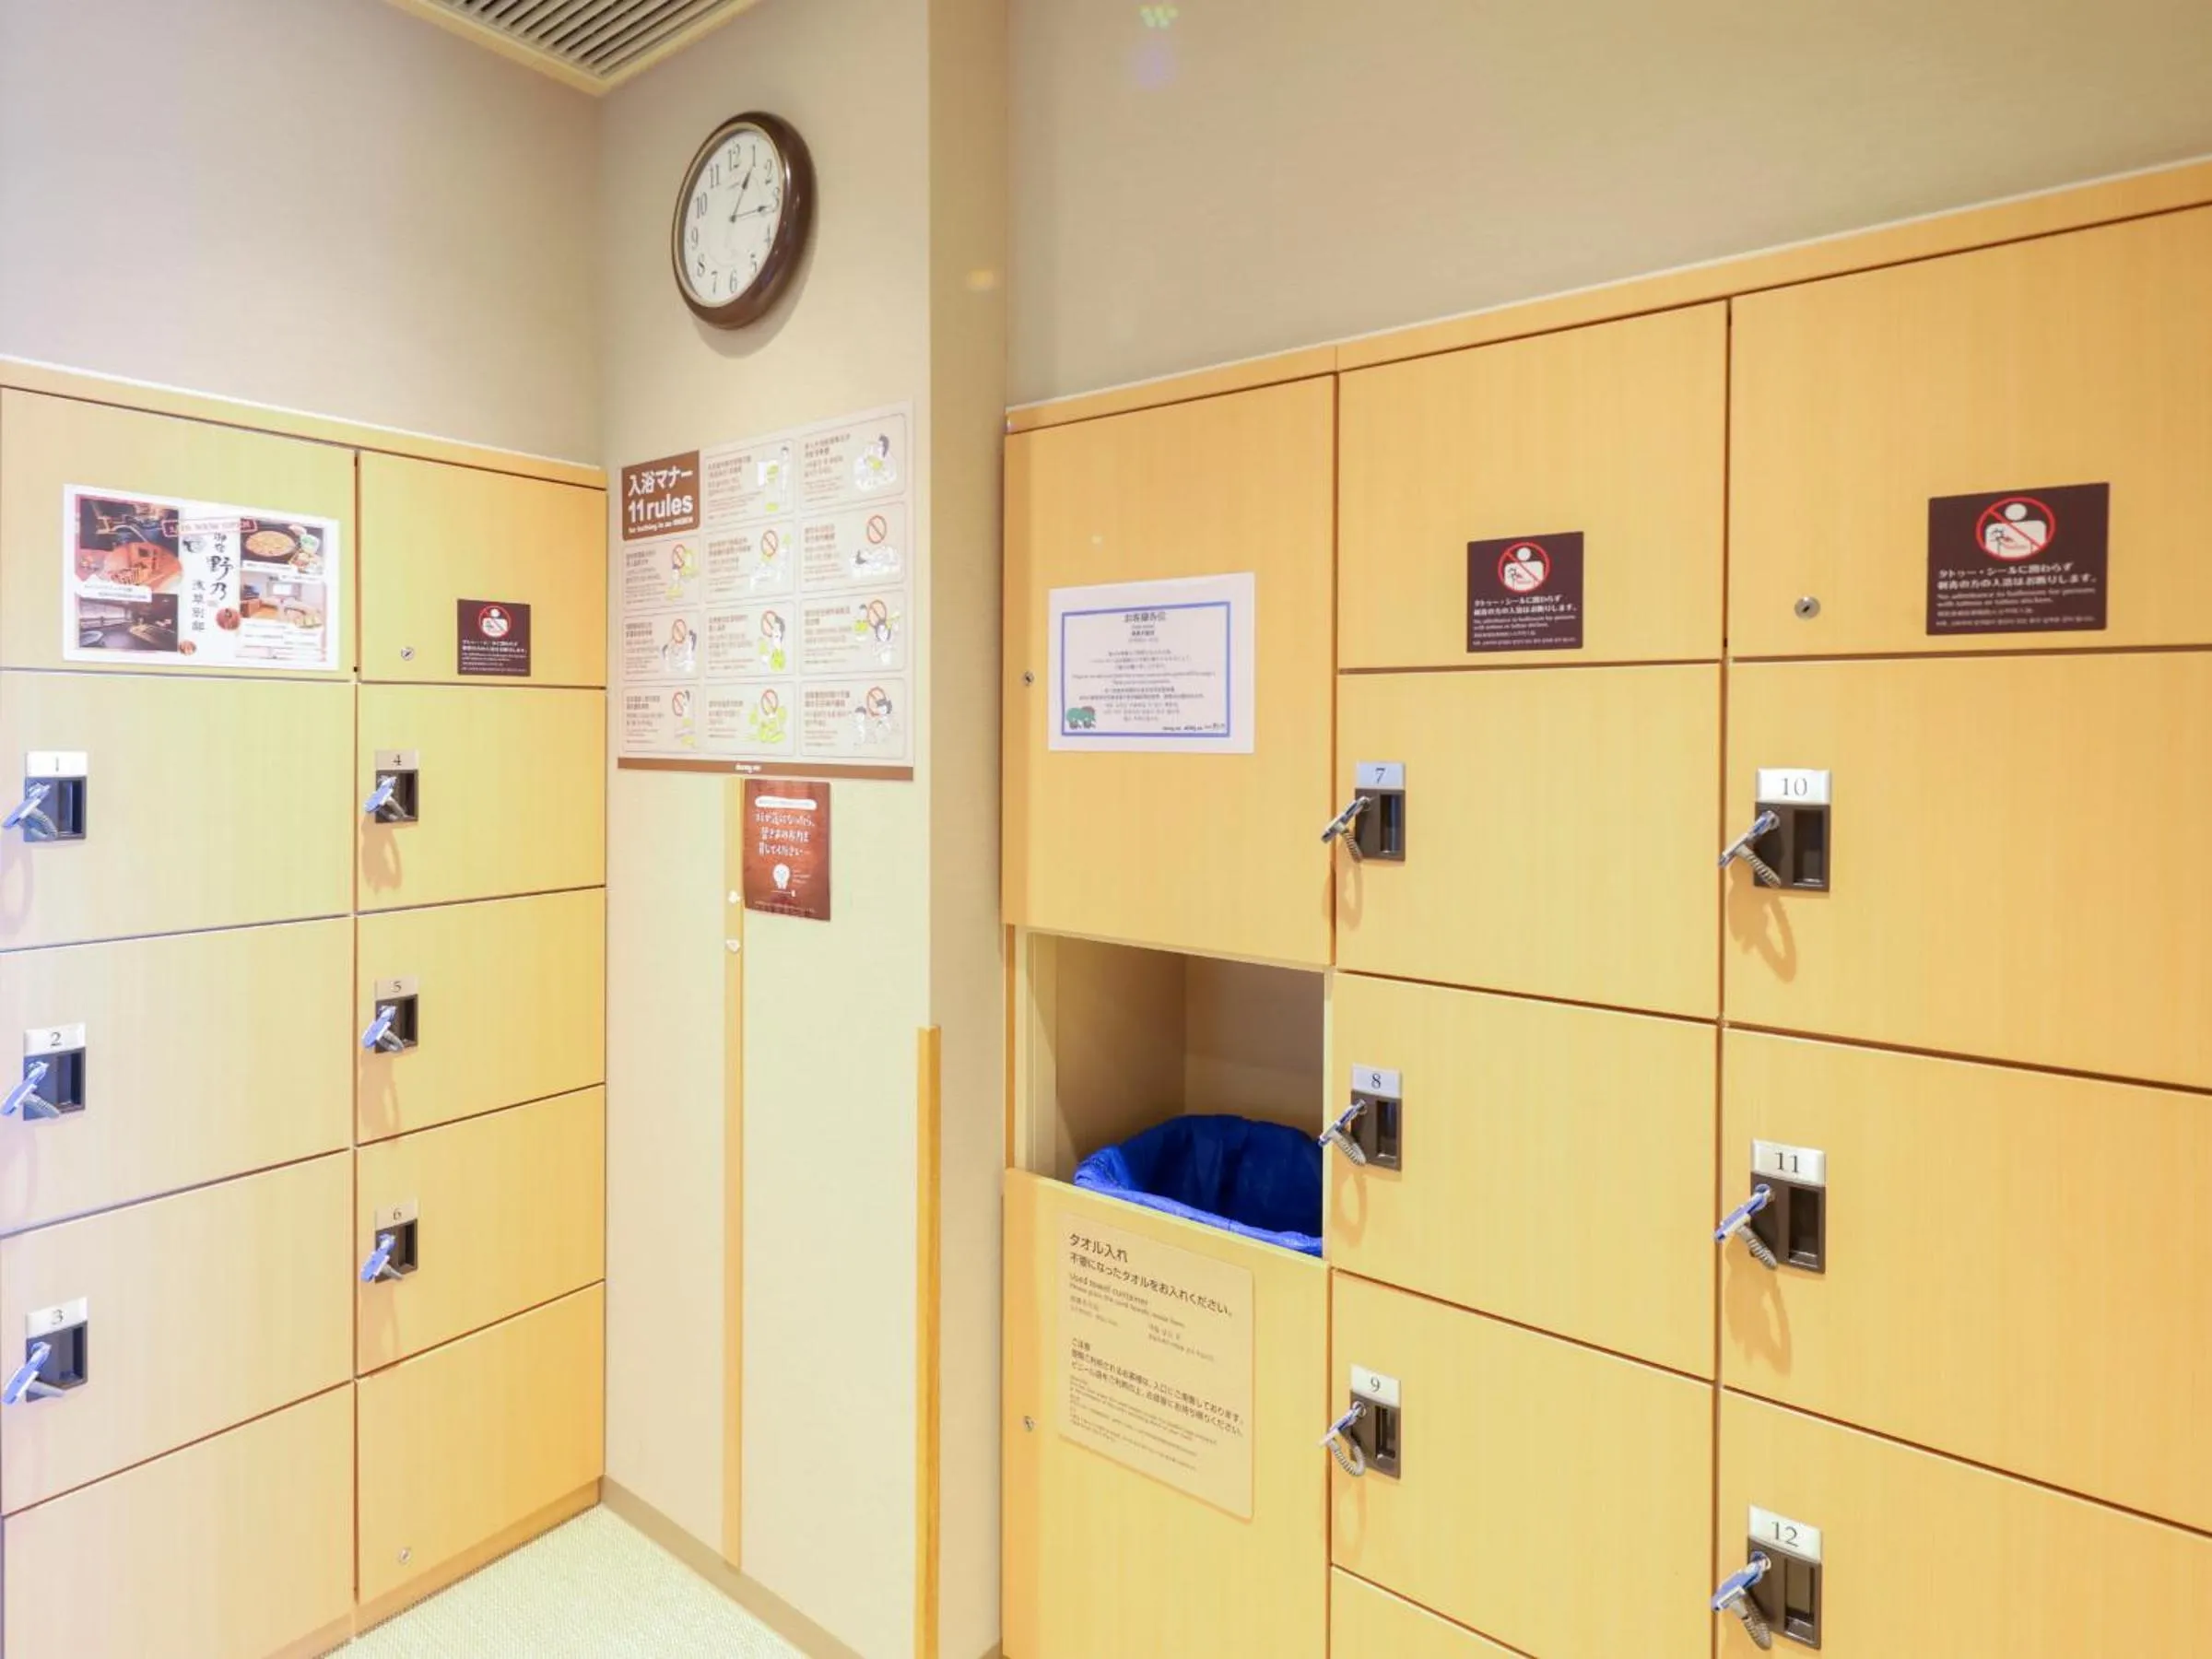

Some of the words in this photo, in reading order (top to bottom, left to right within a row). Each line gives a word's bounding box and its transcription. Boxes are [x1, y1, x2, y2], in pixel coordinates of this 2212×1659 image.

[727, 142, 741, 172] 12
[709, 163, 721, 190] 11
[695, 191, 708, 219] 10
[696, 253, 706, 277] 8
[711, 270, 718, 294] 7
[628, 465, 693, 497] 入浴マナー
[647, 493, 693, 520] rules
[392, 753, 403, 767] 4
[1375, 768, 1386, 783] 7
[1783, 778, 1807, 796] 10
[392, 980, 402, 994] 5
[50, 1031, 62, 1048] 2
[1371, 1073, 1382, 1089] 8
[1775, 1151, 1800, 1173] 11
[392, 1206, 402, 1221] 6
[1069, 1232, 1128, 1263] タオル入れ
[1070, 1252, 1232, 1317] 不要になったタオルをお入れください。
[53, 1309, 64, 1324] 3
[1370, 1377, 1381, 1394] 9
[1771, 1521, 1799, 1547] 12
